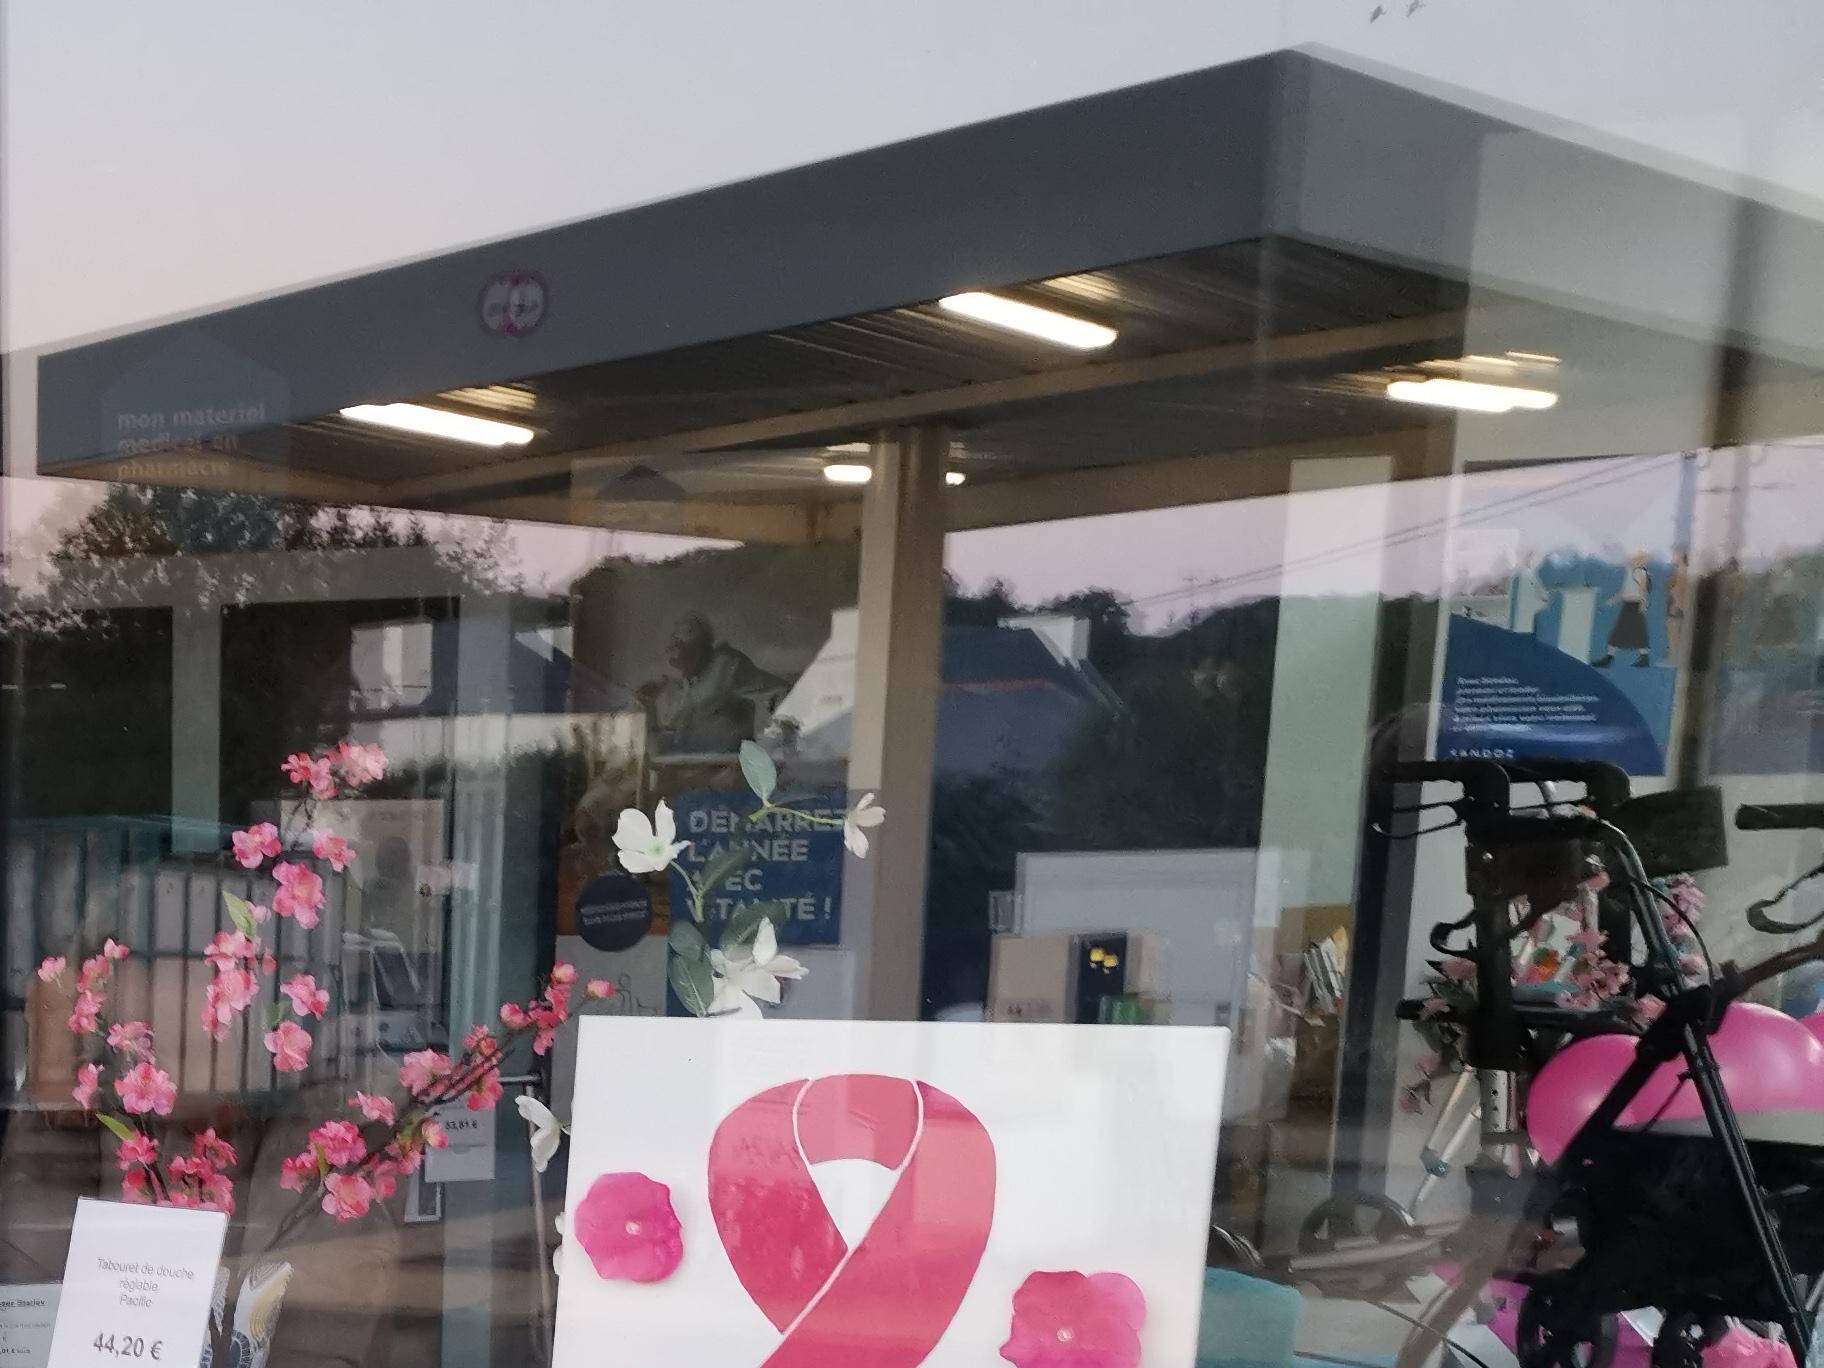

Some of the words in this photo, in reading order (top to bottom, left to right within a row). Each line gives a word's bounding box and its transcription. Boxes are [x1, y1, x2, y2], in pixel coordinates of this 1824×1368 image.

[96, 1258, 139, 1274] Tabouret
[140, 1262, 154, 1276] de
[156, 1263, 195, 1280] douche
[119, 1293, 153, 1308] Pacific
[93, 1332, 145, 1358] 44,20
[150, 1340, 164, 1361] €
